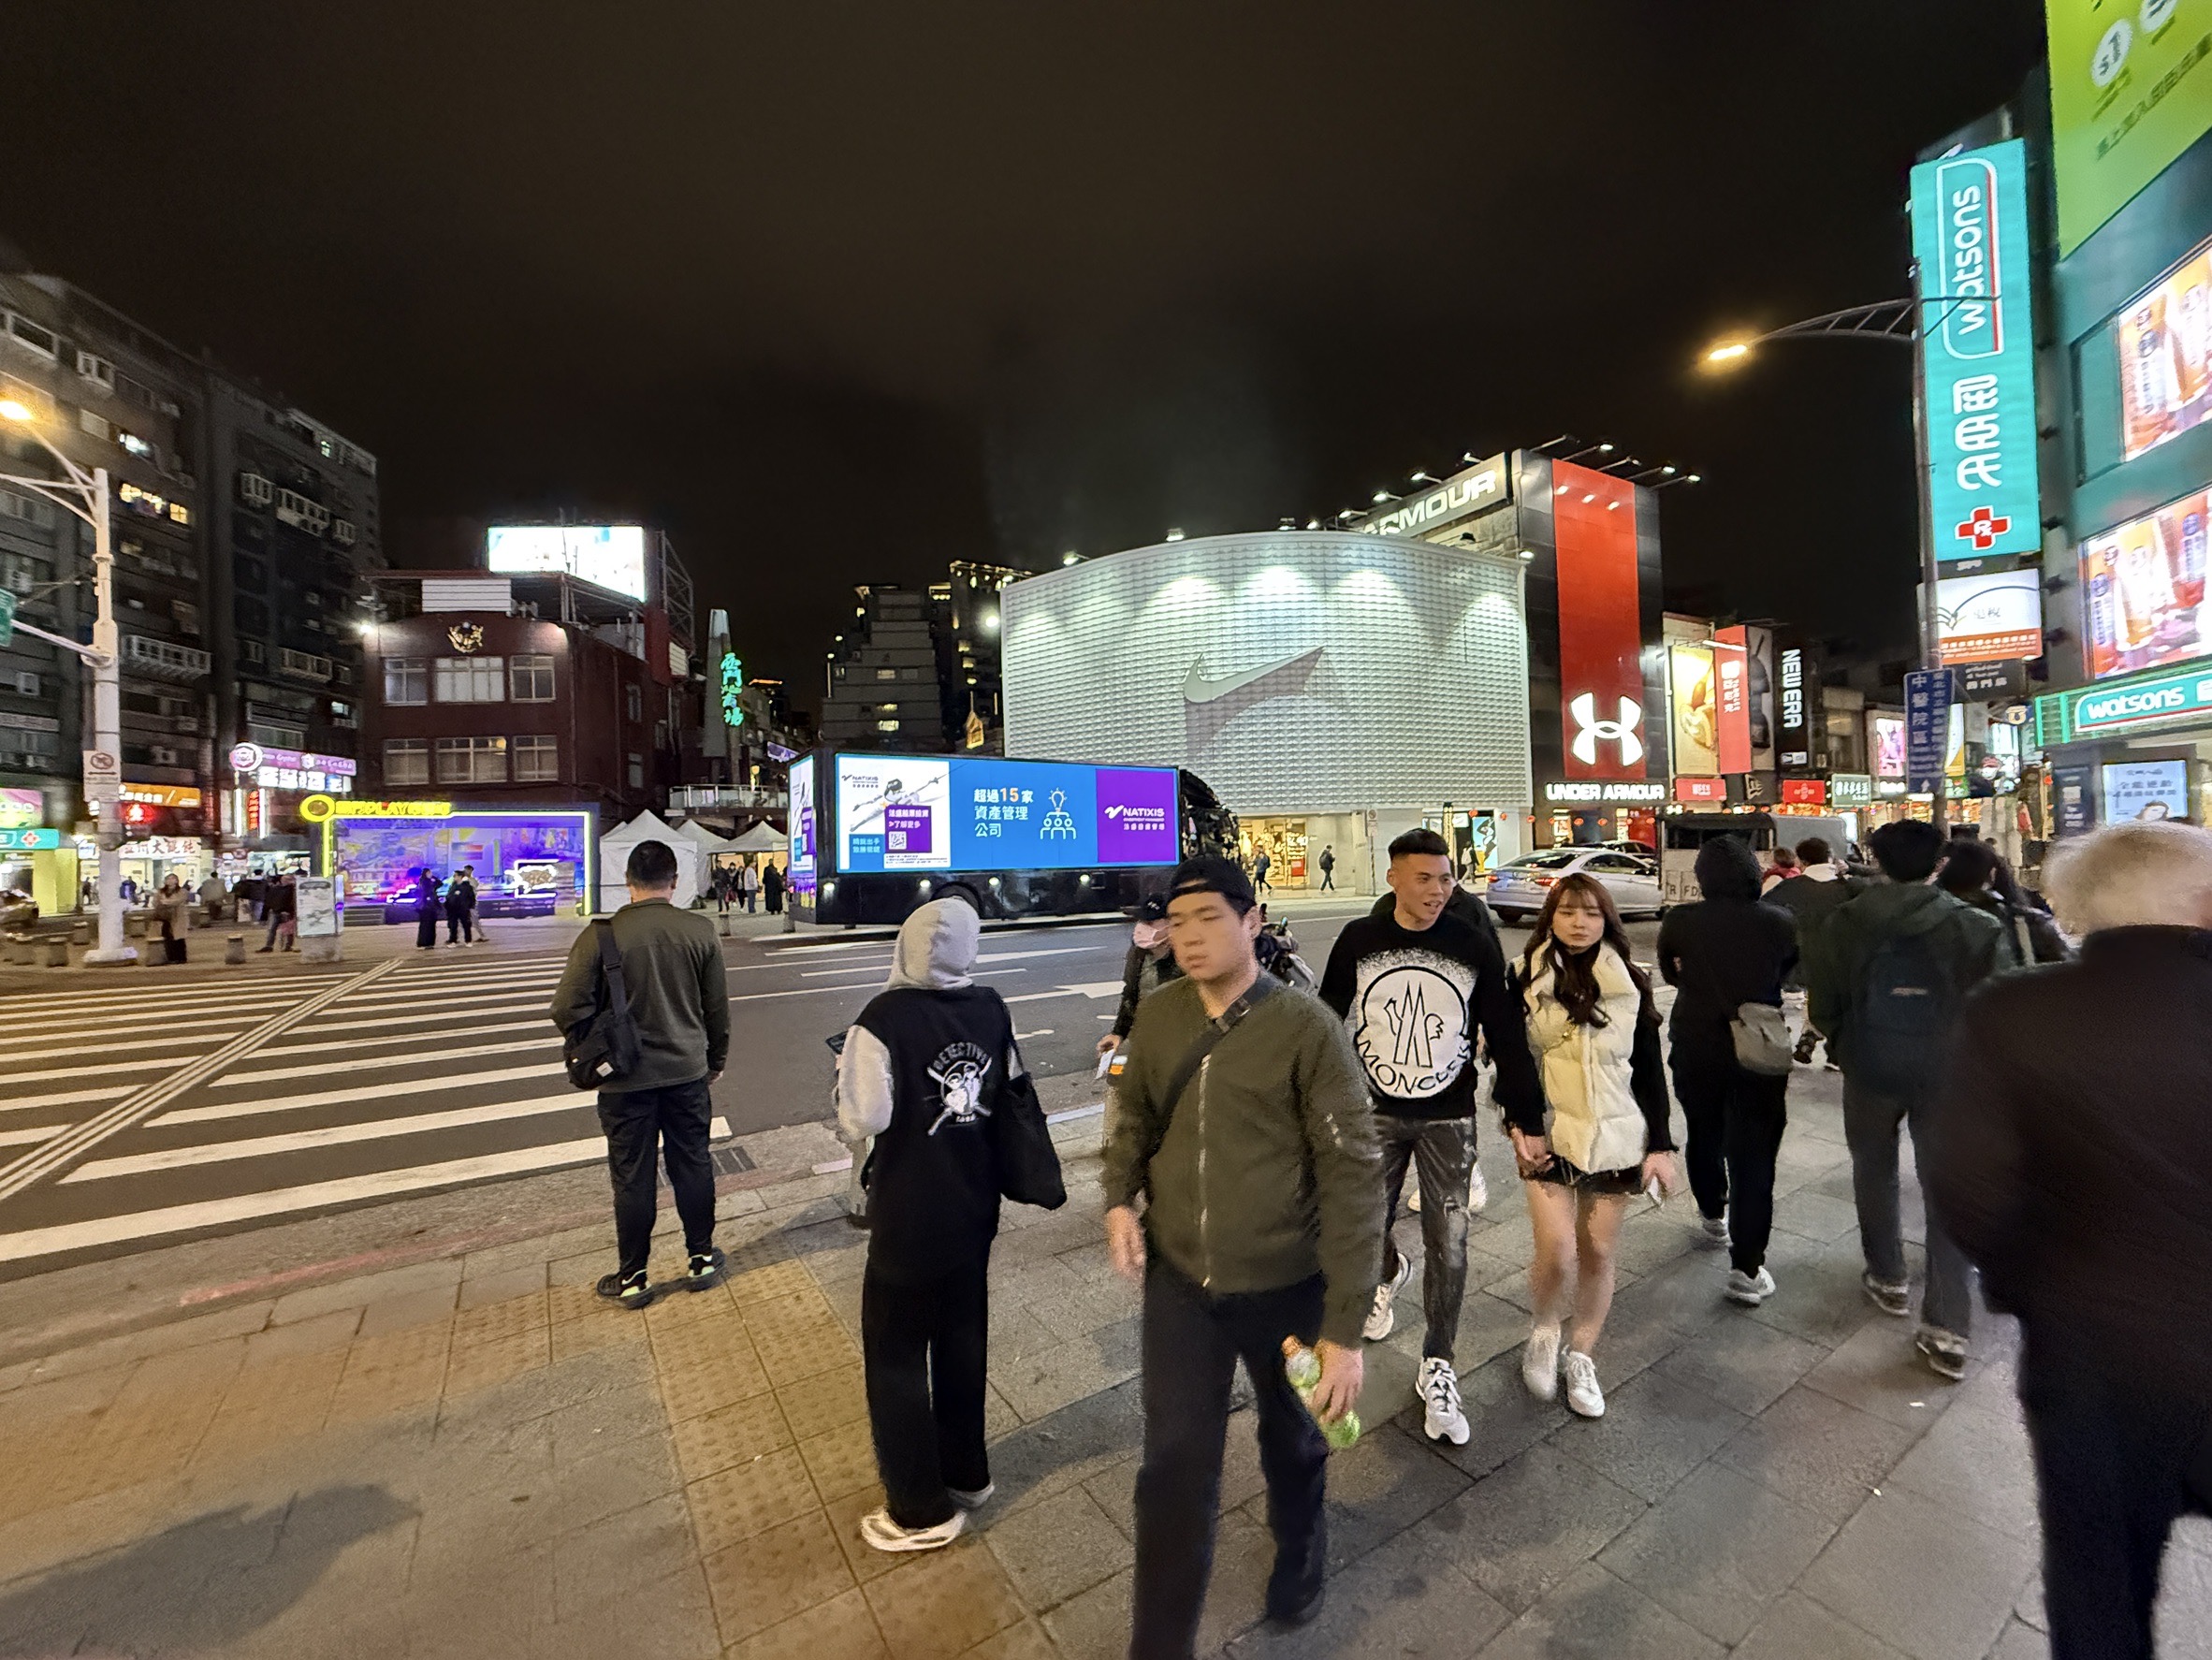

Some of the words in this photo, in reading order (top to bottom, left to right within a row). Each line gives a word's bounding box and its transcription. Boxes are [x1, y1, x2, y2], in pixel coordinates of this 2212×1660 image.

[1952, 185, 1987, 336] watsons
[1953, 374, 2001, 490] 屈臣氏
[1782, 648, 1802, 688] NEW
[1783, 689, 1803, 728] ERA
[2087, 686, 2185, 720] watsons
[1546, 783, 1601, 801] UNDER
[1603, 783, 1666, 800] ARMOUR
[974, 805, 1028, 821] 資產管理
[1123, 807, 1165, 817] NATIXIS
[975, 823, 1001, 837] 公司
